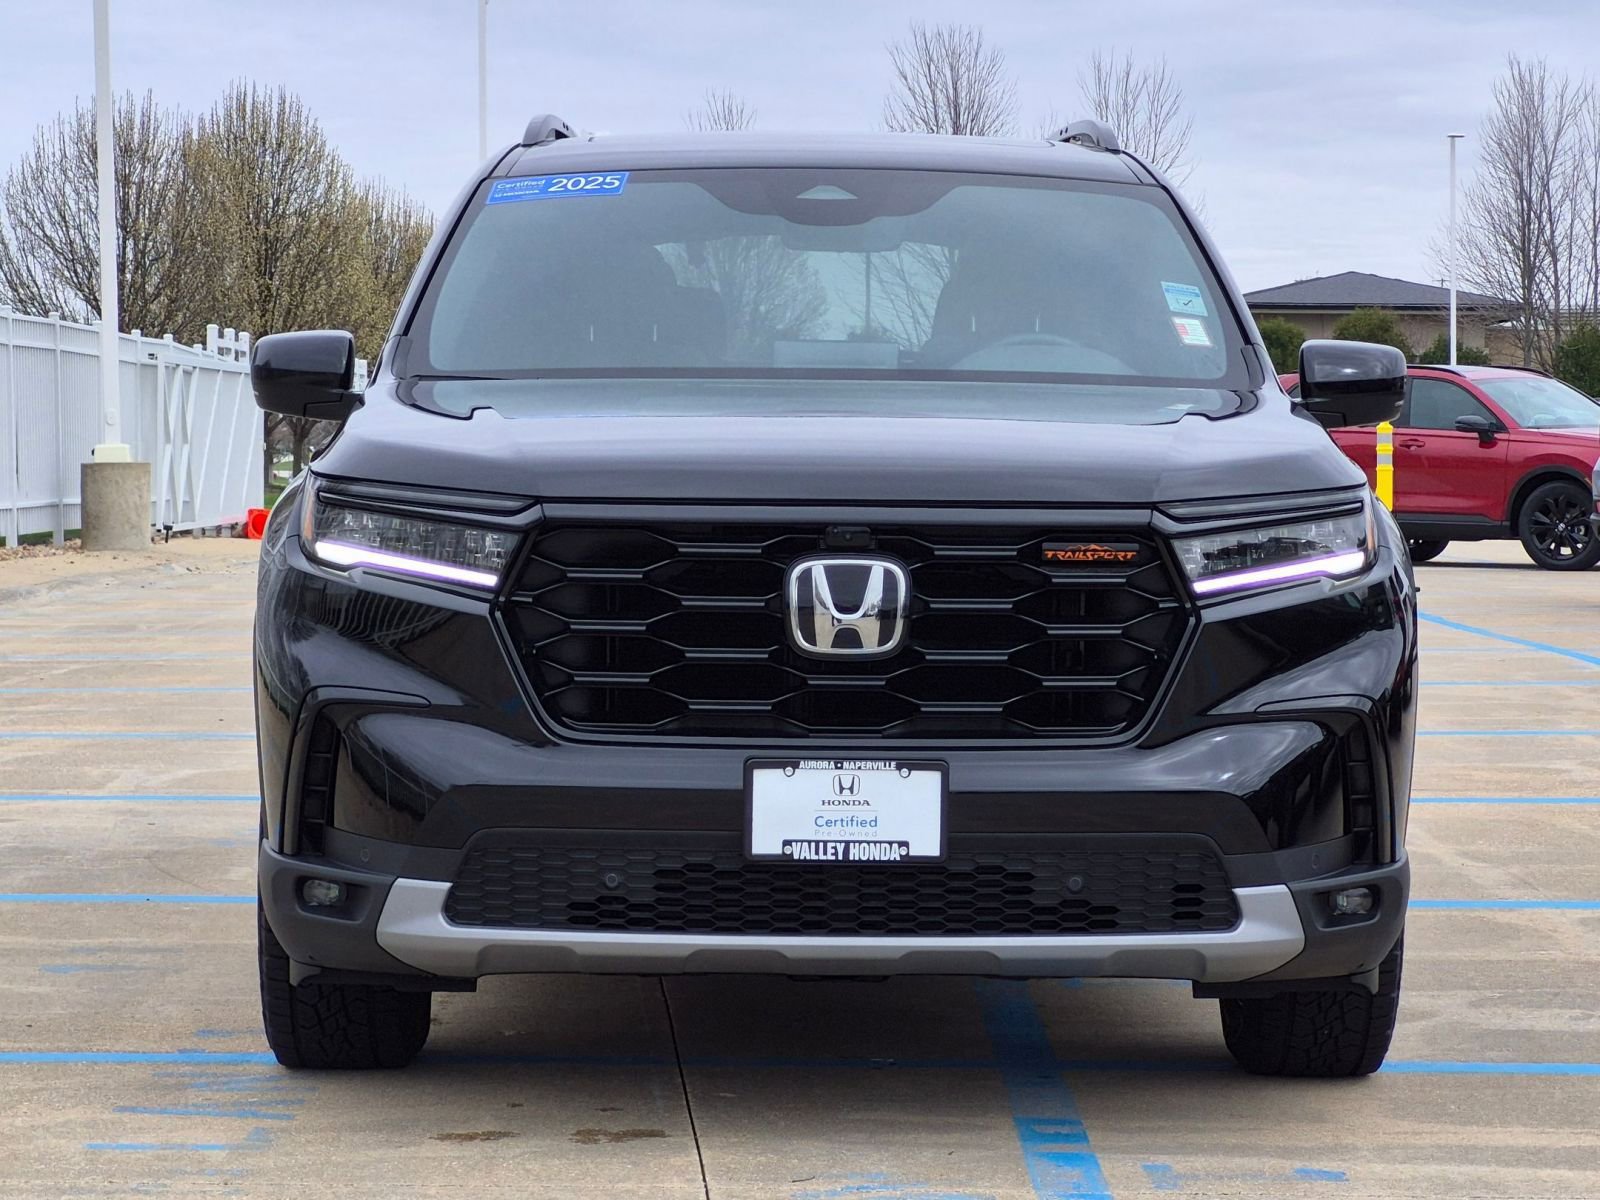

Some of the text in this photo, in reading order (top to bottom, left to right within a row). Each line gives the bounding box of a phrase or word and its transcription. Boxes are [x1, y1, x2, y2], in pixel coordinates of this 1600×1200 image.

[497, 179, 546, 189] Certified
[547, 175, 622, 192] 2025
[1044, 551, 1137, 561] TRAILSPORT
[799, 761, 896, 770] AURORA NAPERVILLE
[814, 815, 878, 827] Certified
[814, 829, 878, 837] Pre-Owned
[792, 842, 901, 861] VALLEY HONDA
